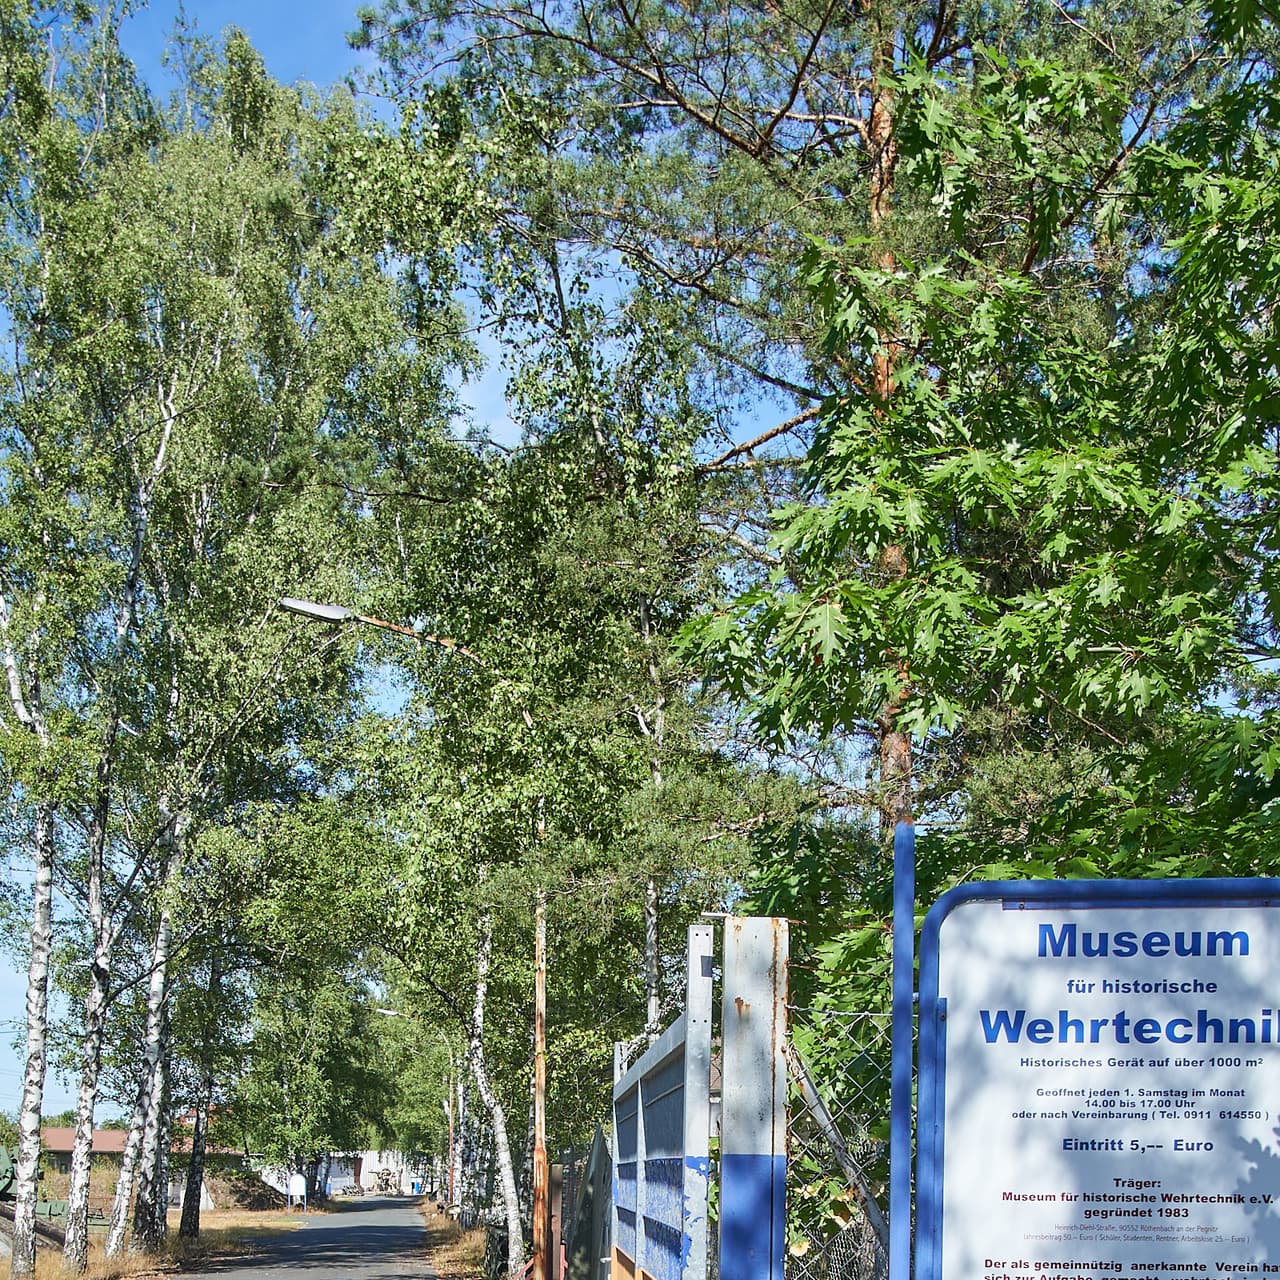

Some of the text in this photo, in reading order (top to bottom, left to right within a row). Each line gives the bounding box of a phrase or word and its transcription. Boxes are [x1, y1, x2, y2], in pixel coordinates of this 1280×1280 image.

[1037, 923, 1250, 958] Museum
[1066, 979, 1217, 993] für historische
[1020, 1056, 1262, 1067] Historisches Gerät auf über 1000 m²
[1036, 1088, 1245, 1098] Geöffnet jeden 1. Samstag im Monat
[1086, 1099, 1195, 1107] 14.00 bis 17.00 Uhr
[1012, 1110, 1037, 1118] oder
[1040, 1110, 1068, 1118] nach
[1071, 1110, 1148, 1120] Vereinbarung
[1159, 1110, 1180, 1119] Tel.
[1184, 1110, 1211, 1119] 0911
[1219, 1110, 1262, 1119] 614550
[1063, 1138, 1124, 1151] Eintritt
[1173, 1139, 1215, 1151] Euro
[1112, 1178, 1161, 1190] Träger:
[1002, 1192, 1274, 1203] Museum für historische Wehrtechnik e.V.
[1084, 1207, 1189, 1219] gegründet 1983
[985, 1259, 1007, 1268] Der
[1011, 1259, 1030, 1268] als
[1034, 1260, 1122, 1272] gemeinnützig
[1131, 1261, 1207, 1271] anerkannte
[1216, 1262, 1258, 1272] Verein
